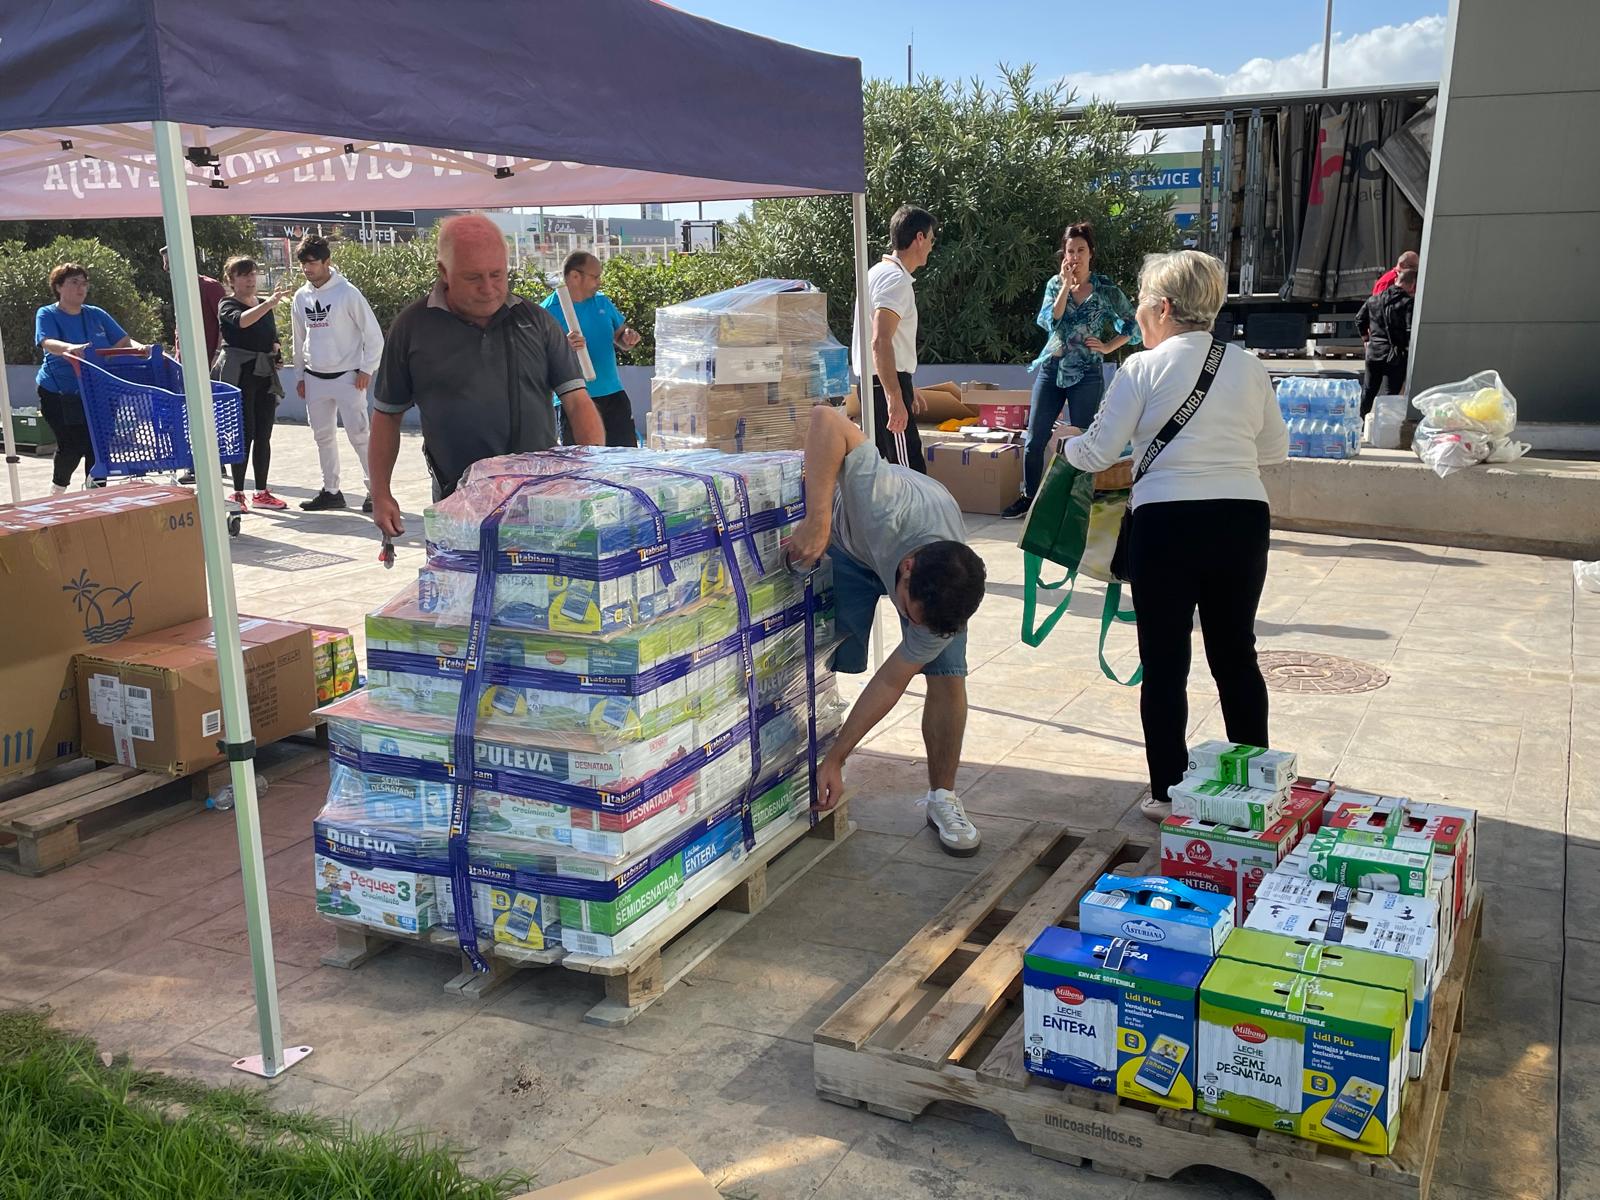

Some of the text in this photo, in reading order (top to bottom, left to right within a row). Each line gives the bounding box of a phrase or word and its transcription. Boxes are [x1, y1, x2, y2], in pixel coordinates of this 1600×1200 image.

[1130, 172, 1190, 189] SERVICE
[359, 228, 397, 242] BUFE
[1204, 343, 1225, 375] BIMBA
[1173, 389, 1205, 426] BIMBA
[1140, 438, 1166, 473] BIMBA
[169, 511, 194, 530] 045
[474, 743, 553, 772] PULEVA
[575, 760, 613, 772] DESNATADA
[626, 787, 674, 824] DESNATADA
[685, 843, 717, 874] ENTERA
[350, 870, 411, 902] Peques 3
[1181, 878, 1219, 893] ENTERA
[615, 872, 679, 926] SEMIDESNATADA
[1125, 924, 1162, 940] ASTURIANA
[1092, 944, 1148, 961] ENERA
[1055, 987, 1085, 1002] Milbona
[1125, 991, 1162, 1006] Lidl Plus
[1056, 1005, 1082, 1018] LECHE
[1260, 1007, 1286, 1019] ENVASE
[1042, 1015, 1097, 1039] ENTERA
[1234, 1024, 1267, 1041] Milbona
[1312, 1031, 1355, 1047] Lidl Plus
[1237, 1044, 1263, 1057] LECHE
[1312, 1042, 1339, 1054] Ventajas
[1344, 1049, 1381, 1062] descuentos
[1233, 1055, 1265, 1072] SEMI
[1216, 1061, 1282, 1087] DESNATADA
[1044, 1113, 1144, 1148] unicoasfaltos.es
